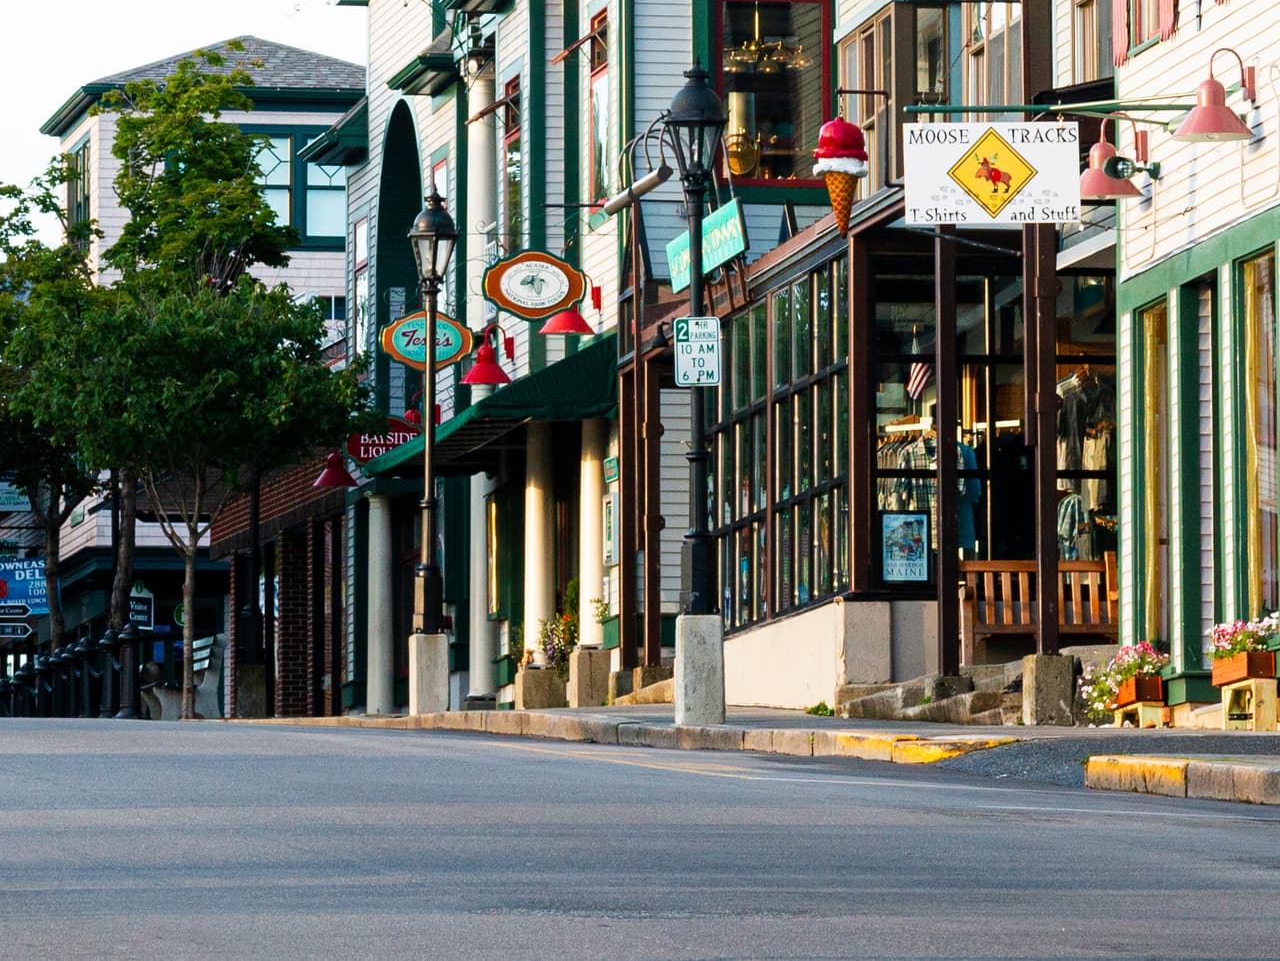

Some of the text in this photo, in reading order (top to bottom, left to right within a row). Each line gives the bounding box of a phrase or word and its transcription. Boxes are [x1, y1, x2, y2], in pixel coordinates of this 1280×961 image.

[909, 127, 1077, 145] MOOSE TRACKS
[909, 207, 967, 222] T-Shirts
[1010, 207, 1035, 221] and
[678, 321, 708, 340] 2 HR
[690, 331, 717, 339] PARKING
[681, 344, 715, 354] 10 AM
[691, 358, 705, 368] TO
[682, 370, 715, 381] 6 PM
[15, 569, 45, 581] DEL
[887, 568, 925, 576] MAINE
